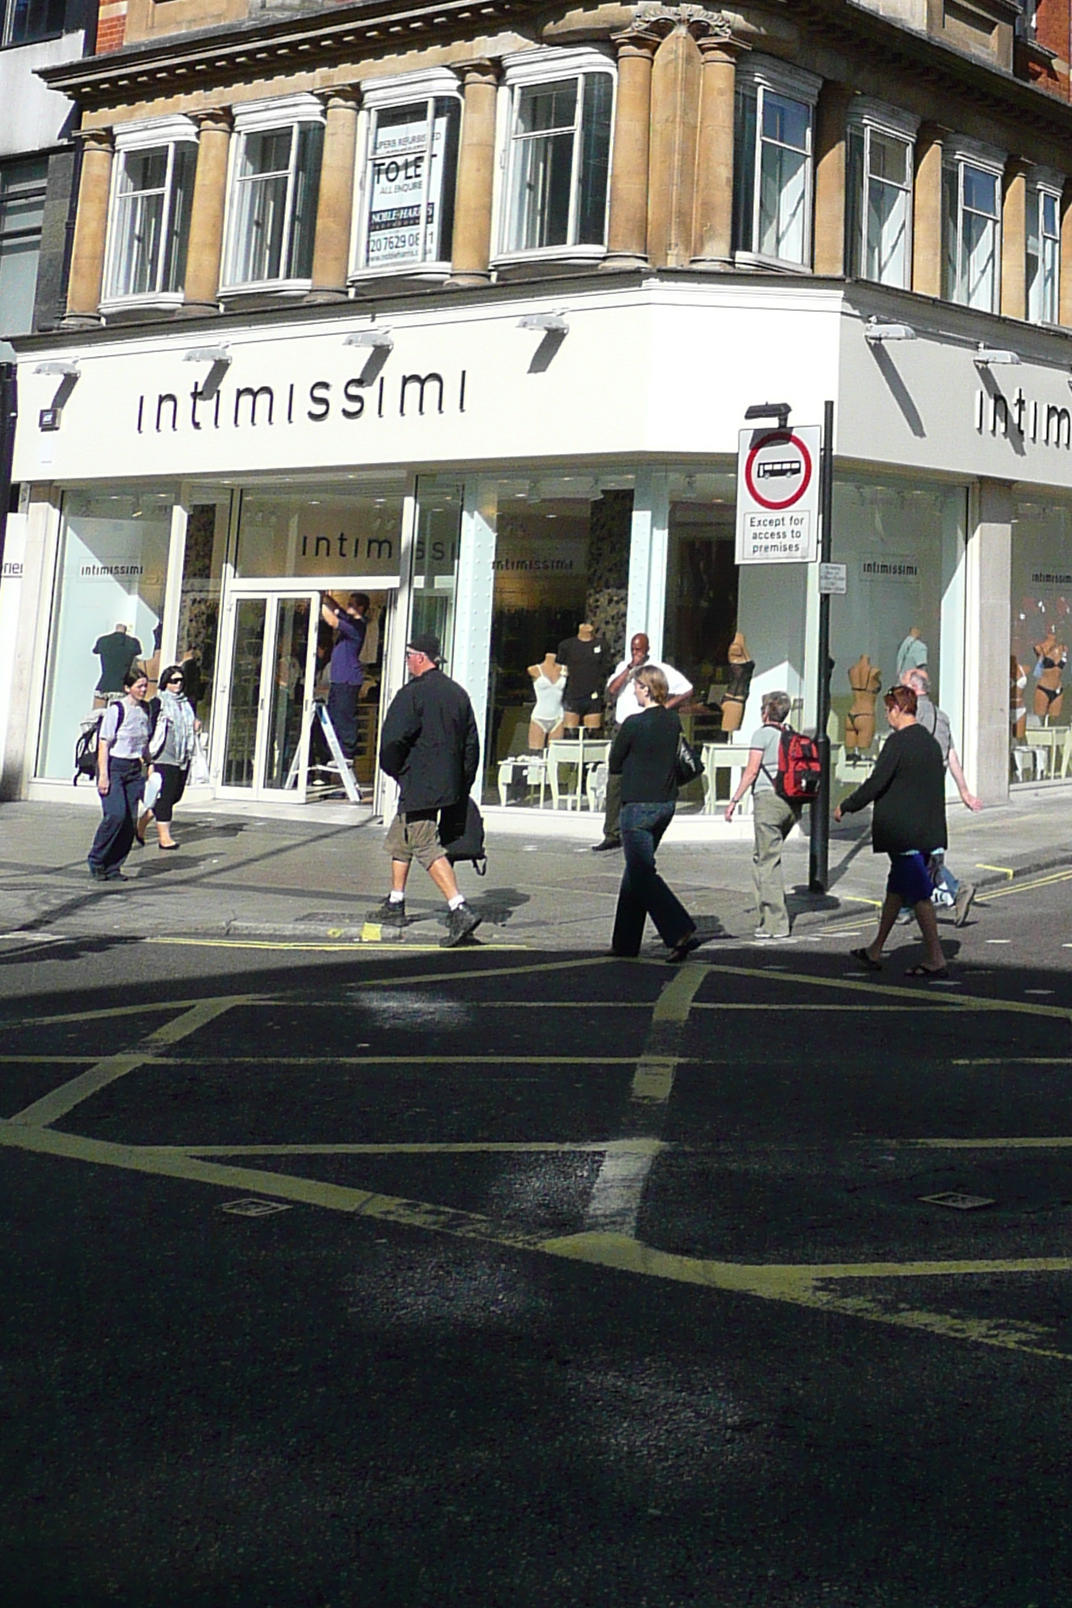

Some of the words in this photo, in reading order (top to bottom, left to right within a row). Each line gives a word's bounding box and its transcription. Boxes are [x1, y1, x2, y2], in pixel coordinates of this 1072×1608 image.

[373, 159, 400, 185] TO
[380, 184, 393, 195] ALL
[370, 236, 382, 252] 20
[383, 233, 406, 251] 7629
[138, 370, 467, 433] intimissimi
[749, 516, 786, 528] Except
[789, 515, 805, 526] for
[751, 531, 787, 540] access
[791, 529, 802, 539] to
[752, 542, 800, 554] premises
[81, 564, 144, 576] intimissimi
[492, 558, 574, 571] intimissimi
[863, 560, 918, 576] intimissimi
